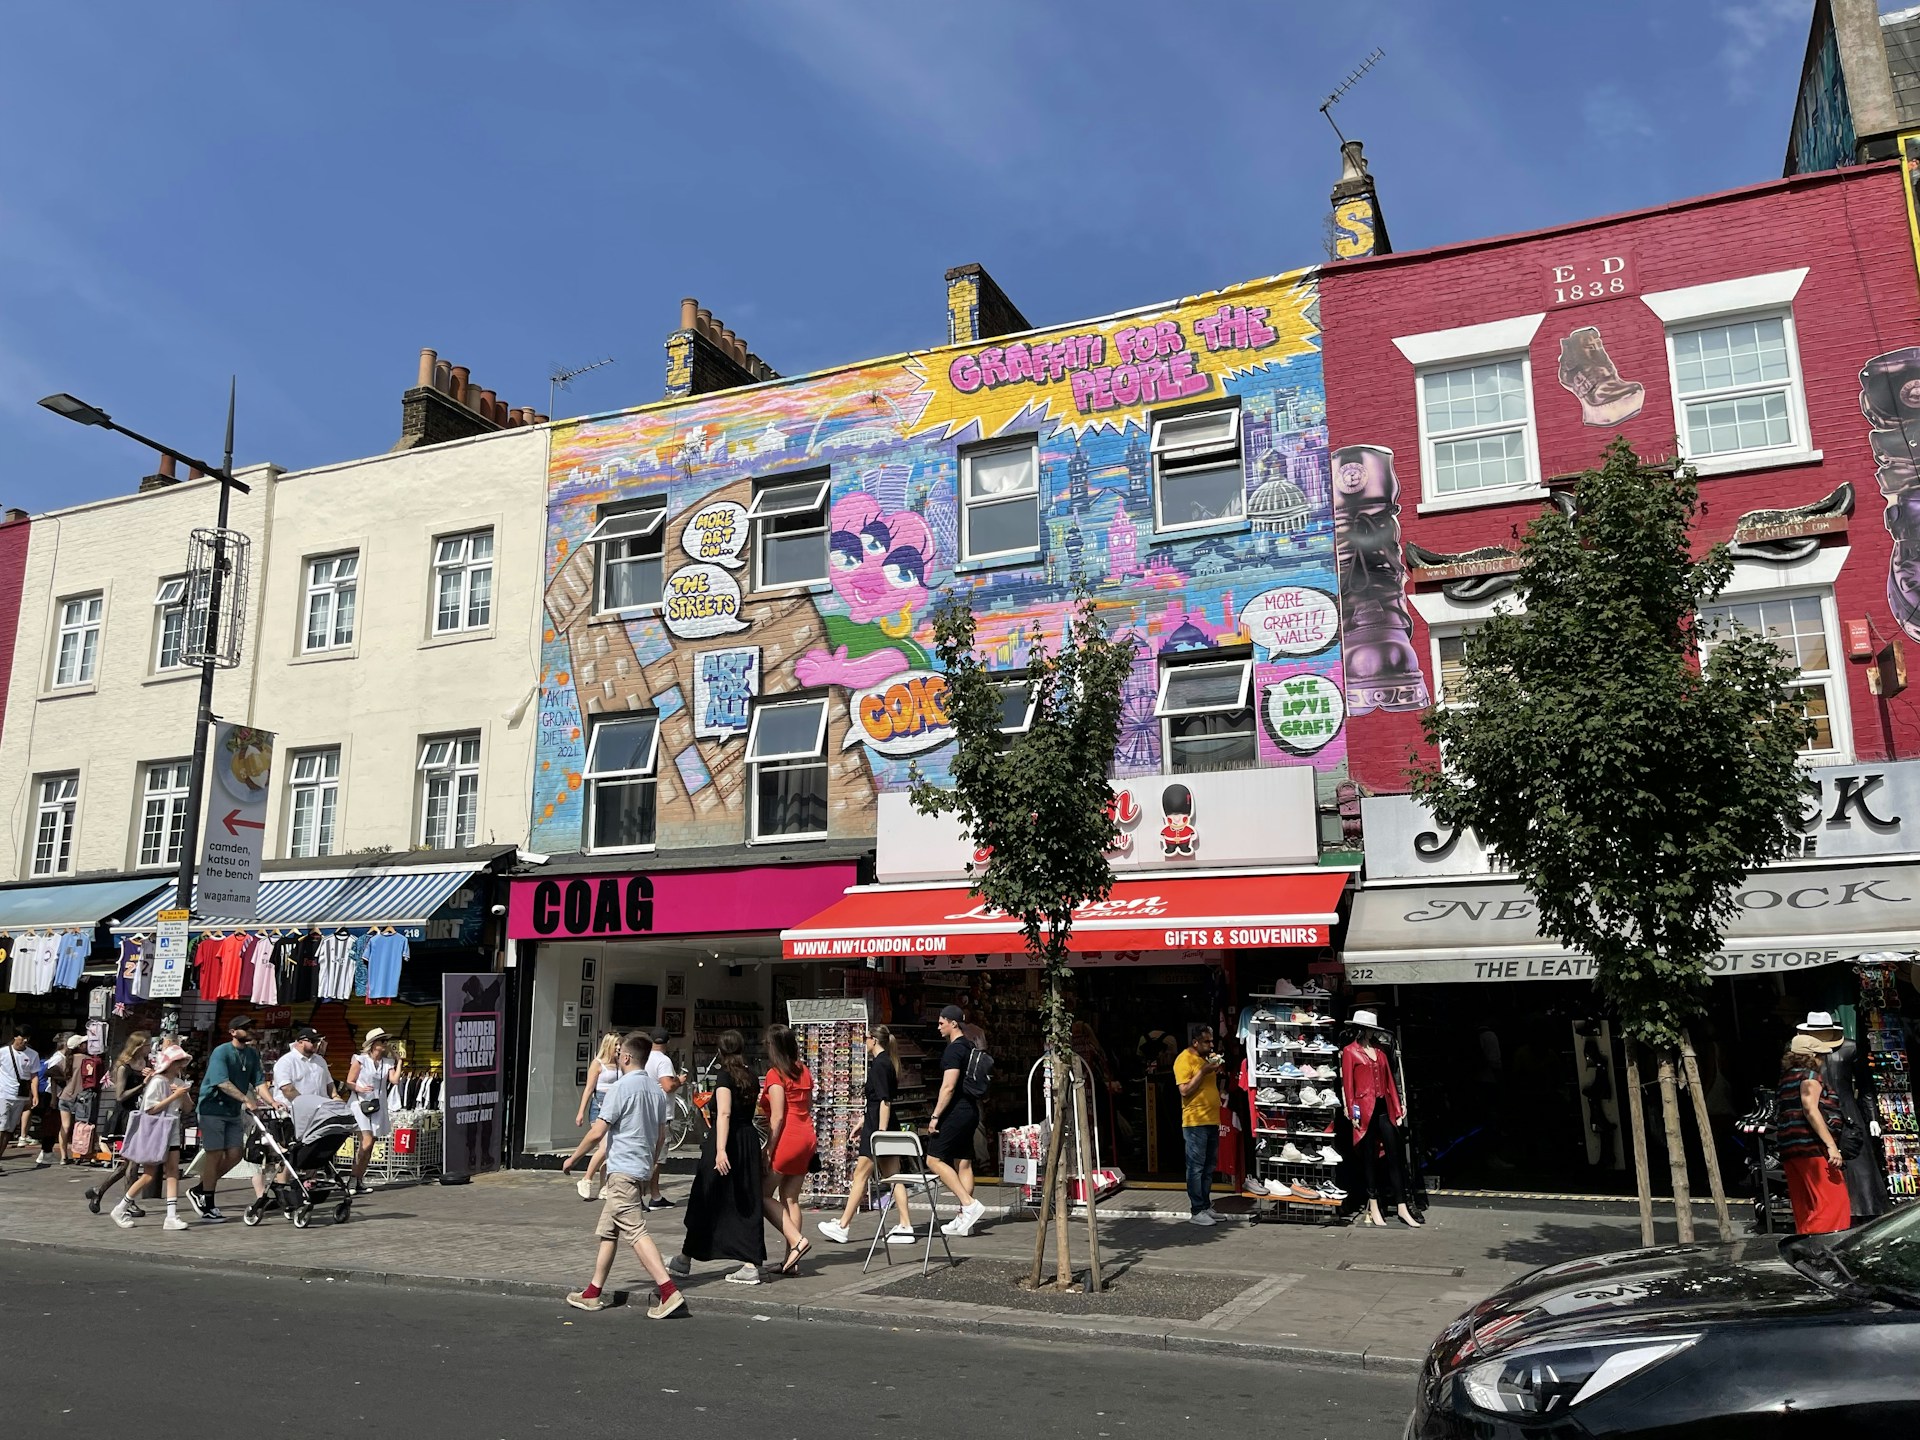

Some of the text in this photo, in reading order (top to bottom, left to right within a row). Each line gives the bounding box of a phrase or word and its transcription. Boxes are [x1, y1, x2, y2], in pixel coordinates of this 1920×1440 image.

[1336, 200, 1374, 257] S
[1552, 256, 1625, 284] E D
[1554, 277, 1625, 303] 1838
[949, 304, 1279, 394] GRAFFITI FOR THE
[1070, 350, 1213, 413] PEOPLE
[695, 510, 735, 530] MORE
[701, 528, 735, 545] ART
[671, 573, 710, 594] THE
[668, 594, 736, 620] STREETS
[1265, 592, 1304, 610] MORE
[1264, 610, 1325, 630] GRAFFITI
[703, 653, 754, 682] ART
[709, 679, 753, 701] FOR
[1284, 680, 1319, 696] WE
[705, 699, 747, 730] ALL
[860, 676, 953, 742] COAG
[1280, 718, 1334, 737] GRAFF
[209, 842, 251, 856] camden,
[207, 854, 250, 867] katsu on
[206, 867, 254, 880] the bench
[204, 889, 251, 903] wagamama
[1403, 880, 1912, 922] NE OCK
[533, 876, 654, 935] COAG
[403, 928, 420, 938] 218
[1164, 928, 1318, 946] GIFTS & SOUVENIRS
[793, 937, 947, 955] WWW.NW1LONDON.COM
[167, 961, 173, 969] P
[1474, 962, 1519, 979] THE
[1526, 959, 1600, 977] LEATH
[1751, 951, 1838, 969] STORE
[1351, 970, 1373, 979] 212
[455, 1021, 495, 1037] CAMDEN
[455, 1036, 495, 1052] OPEN AIR
[455, 1051, 495, 1068] GALLERY
[450, 1091, 499, 1108] CAMDEN TOWN
[456, 1109, 493, 1125] STREET ART
[401, 1134, 410, 1149] £1
[1015, 1164, 1026, 1174] £2
